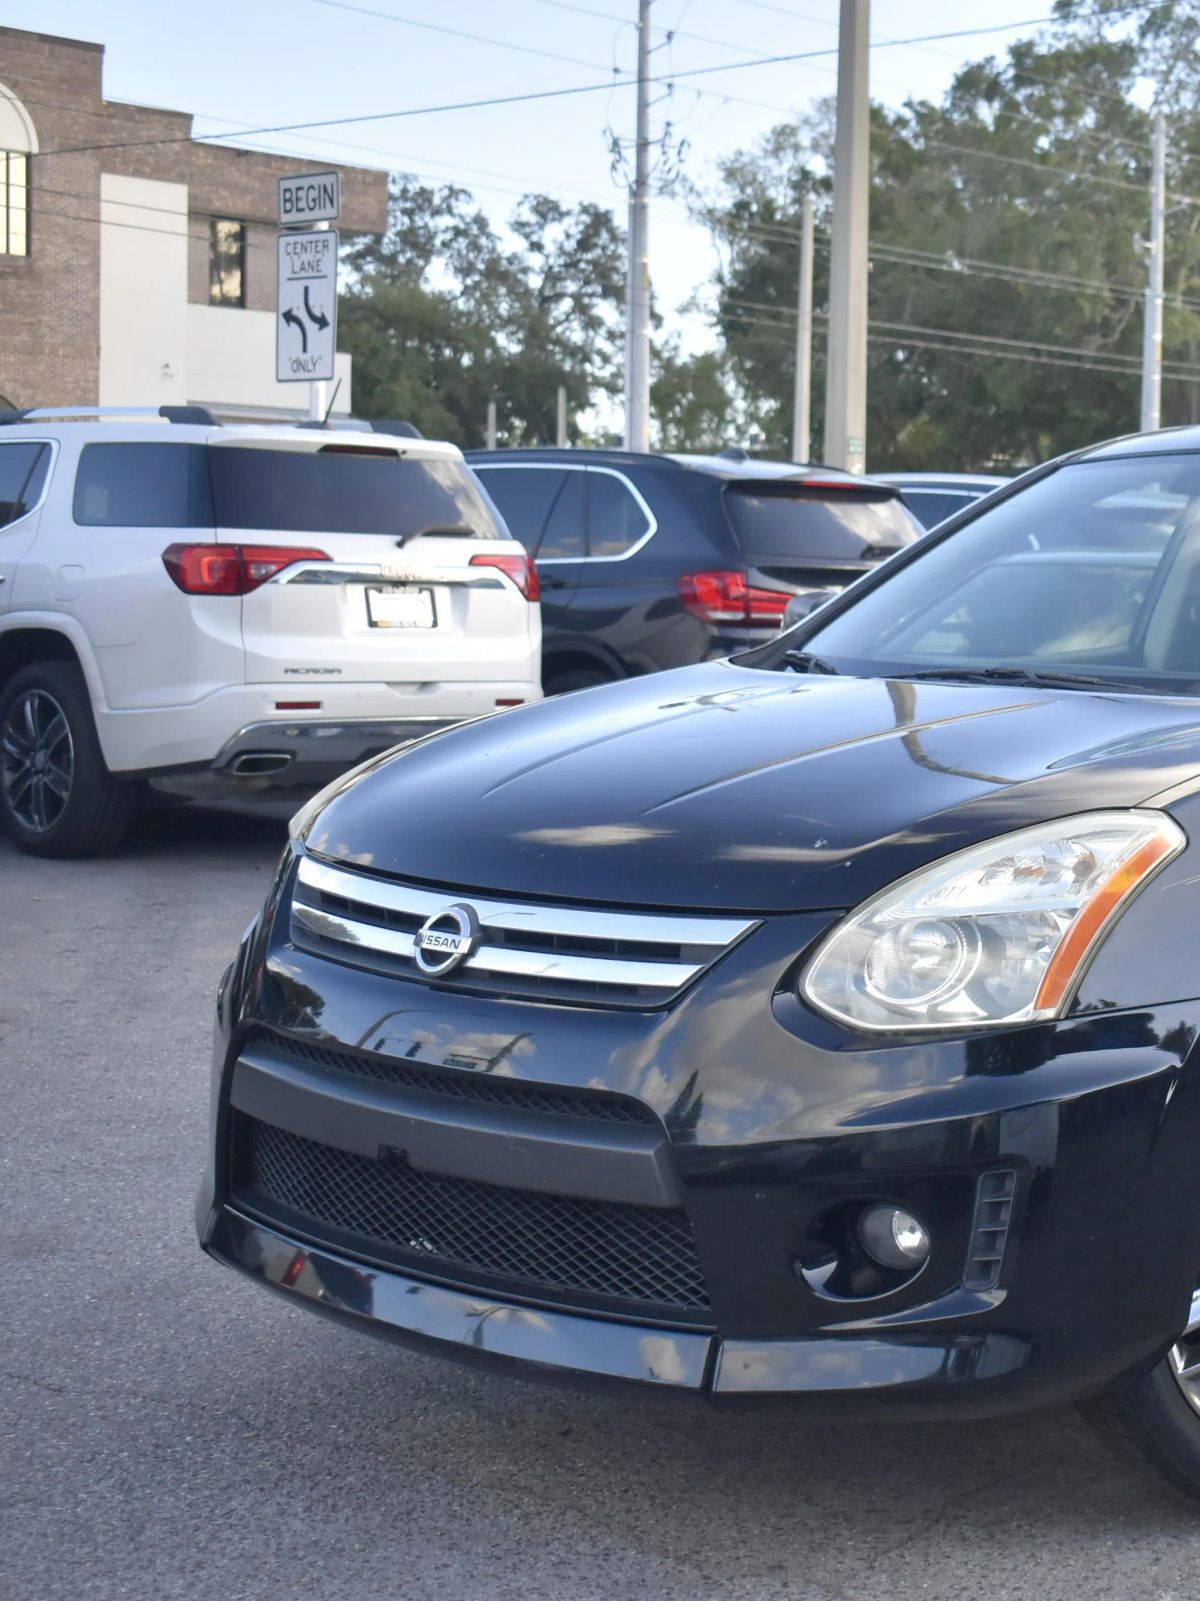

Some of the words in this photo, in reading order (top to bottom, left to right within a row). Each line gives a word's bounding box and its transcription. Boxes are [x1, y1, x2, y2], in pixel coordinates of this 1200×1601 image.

[282, 183, 335, 214] BEGIN
[284, 239, 330, 257] CENTER
[290, 258, 323, 275] LANE
[291, 358, 318, 374] ONLY
[418, 931, 462, 950] NISSAN
